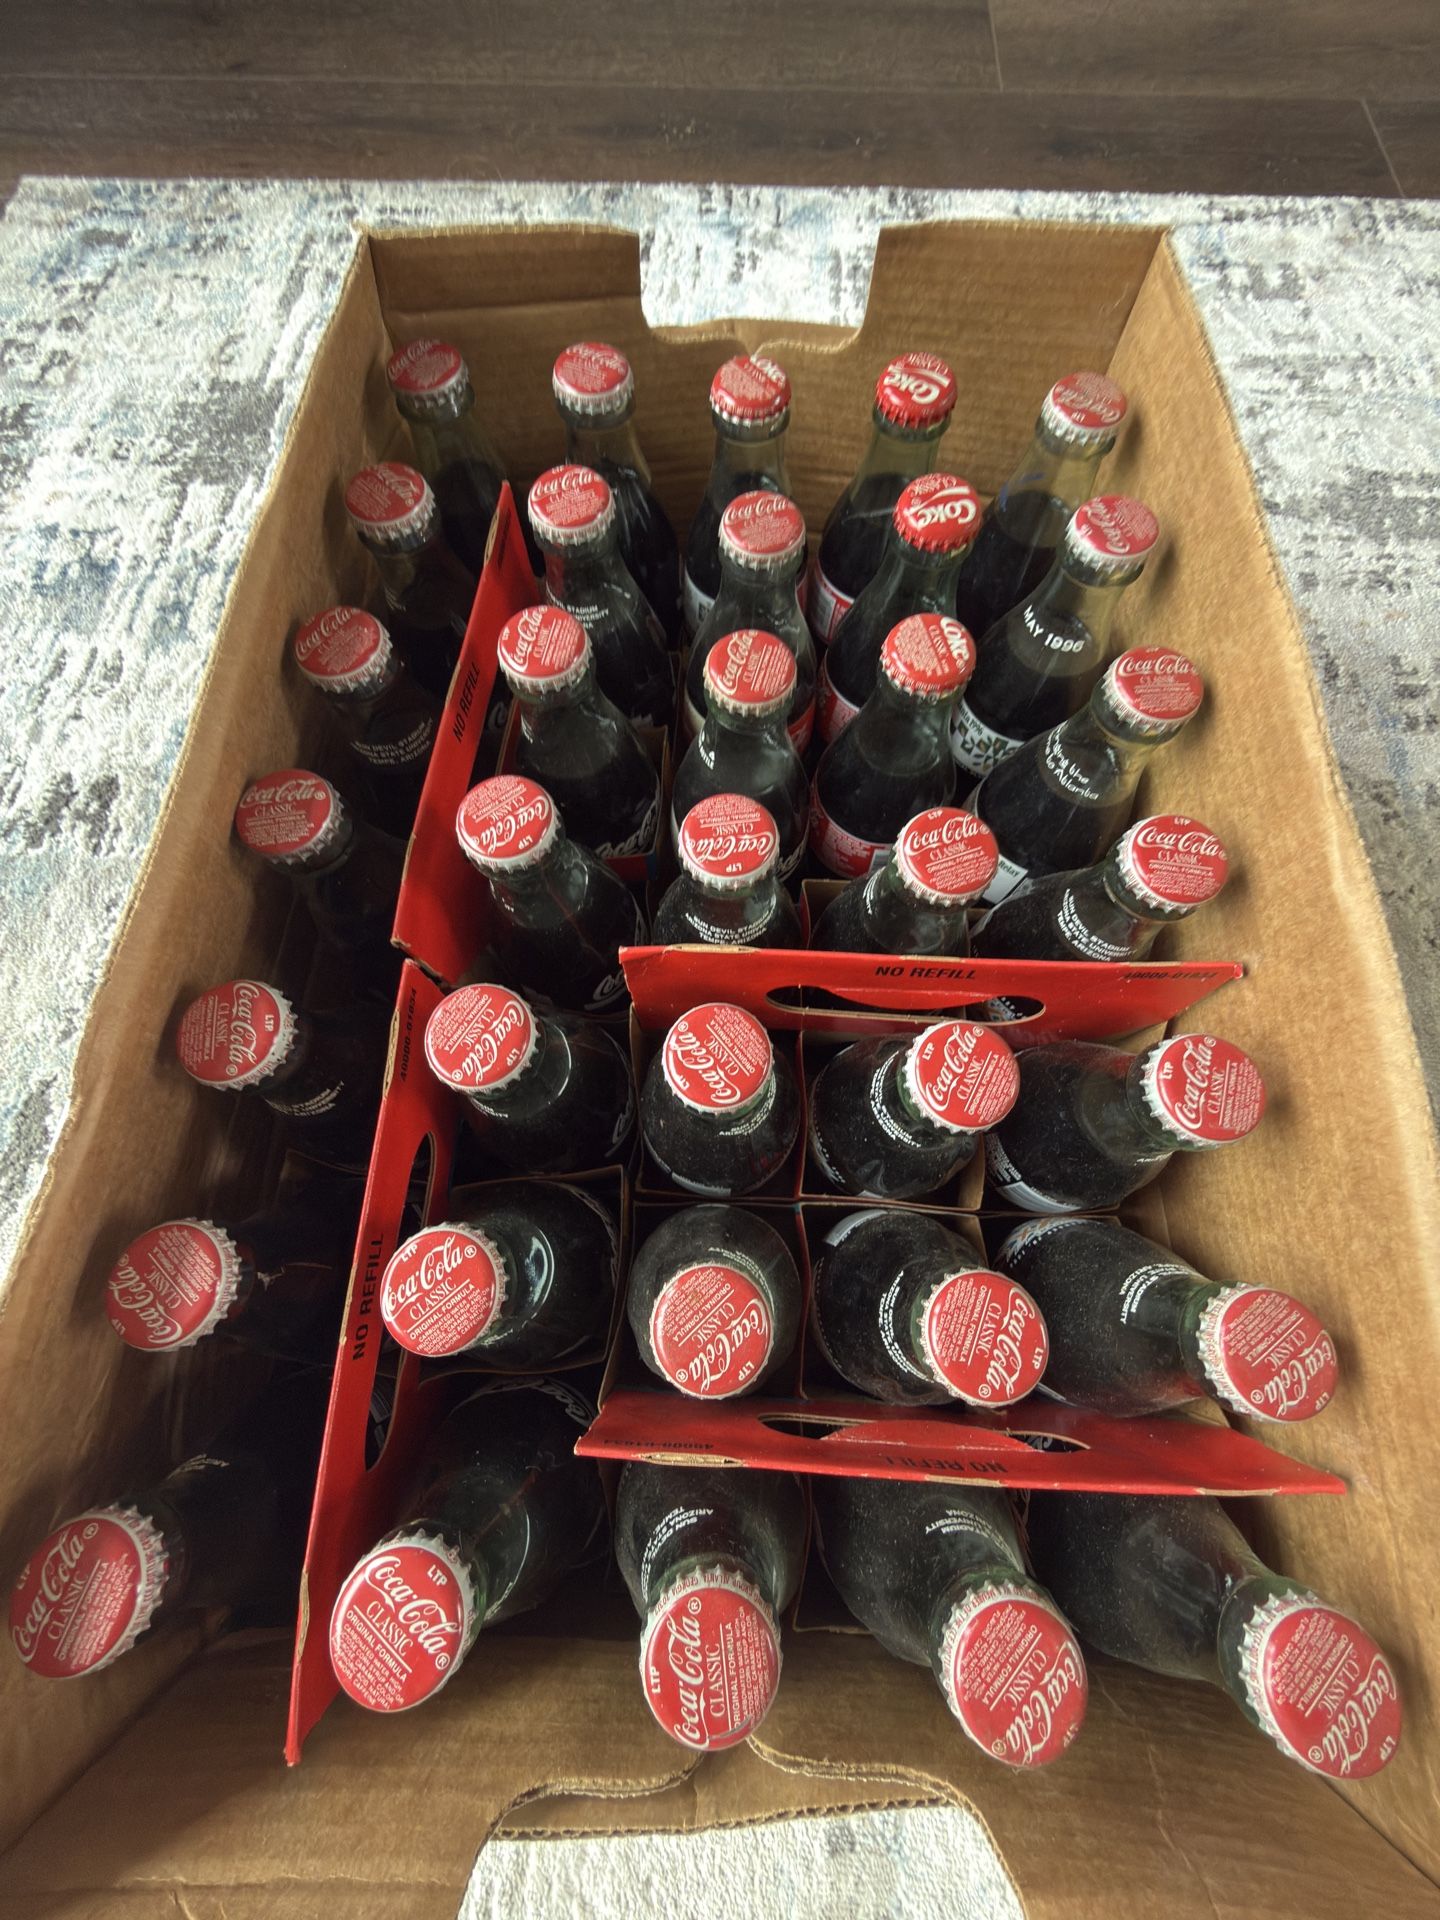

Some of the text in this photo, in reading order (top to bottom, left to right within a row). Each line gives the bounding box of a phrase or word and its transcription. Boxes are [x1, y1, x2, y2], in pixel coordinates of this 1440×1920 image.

[884, 371, 940, 404] Coke
[532, 469, 592, 500] Coca-Cola
[725, 496, 787, 525] Coca-Cola
[913, 500, 976, 530] Coke
[566, 604, 598, 614] STADIUM
[1024, 604, 1044, 637] MAY
[296, 609, 352, 660] Coca-Cola
[501, 610, 542, 673] Coca-Cola
[941, 617, 970, 665] Coke
[718, 632, 752, 695] Coca-Cola
[1119, 655, 1189, 677] Coca-Cola
[453, 662, 480, 744] NO REFILL
[242, 780, 318, 808] Coca-Cola
[255, 802, 294, 817] CLASSIC
[486, 796, 525, 825] CLASSIC
[481, 795, 549, 854] Coca-Cola
[713, 824, 754, 836] CLASSIC
[906, 815, 978, 855] Coca-Cola
[1138, 826, 1219, 856] Coca-Cola
[696, 831, 774, 865] Coca-Cola
[726, 863, 742, 872] LTP
[930, 842, 971, 860] CLASSIC
[1158, 851, 1201, 865] CLASSIC
[694, 916, 708, 928] SUN
[1068, 922, 1089, 943] STATE
[1072, 914, 1088, 937] DEVIL
[1090, 935, 1130, 951] STADIUM
[1072, 940, 1110, 961] ARIZONA
[874, 966, 976, 980] NO REFILL
[229, 983, 259, 1064] Coca-Cola
[265, 1014, 274, 1031] LTP
[462, 1009, 495, 1049] CLASSIC
[462, 1001, 525, 1083] Coca-Cola
[671, 1031, 741, 1104] Coca-Cola
[708, 1039, 738, 1075] CLASSIC
[922, 1043, 934, 1059] LTP
[924, 1025, 974, 1111] Coca-Cola
[957, 1057, 979, 1100] CLASSIC
[1174, 1039, 1214, 1129] Coca-Cola
[401, 1244, 418, 1261] LTP
[353, 1232, 384, 1360] NO REFILL
[382, 1235, 462, 1321] Coca-Cola
[409, 1277, 456, 1320] CLASSIC
[110, 1262, 182, 1343] Coca-Cola
[410, 1311, 442, 1339] ORIGINAL
[442, 1284, 475, 1312] FORMULA
[689, 1299, 766, 1392] Coca-Cola
[691, 1302, 734, 1348] CLASSIC
[976, 1302, 1001, 1358] CLASSIC
[987, 1287, 1035, 1396] Coca-Cola
[1032, 1348, 1043, 1370] LTP
[1271, 1329, 1305, 1370] CLASSIC
[739, 1363, 754, 1380] LTP
[1264, 1329, 1335, 1415] Coca-Cola
[1316, 1392, 1329, 1410] LTP
[669, 1509, 713, 1526] ARIZONA
[676, 1517, 698, 1531] SUN
[12, 1528, 85, 1663] Coca-Cola
[427, 1565, 448, 1586] LTP
[48, 1570, 88, 1639] CLASSIC
[364, 1556, 458, 1655] Coca-Cola
[346, 1611, 408, 1682] ORIGINAL FORMULA
[367, 1600, 413, 1656] CLASSIC
[651, 1667, 661, 1694] LTP
[667, 1614, 709, 1748] Coca-Cola
[705, 1644, 725, 1717] CLASSIC
[982, 1625, 1038, 1705] ORIGINAL FORMULA
[1004, 1650, 1047, 1710] CLASSIC
[1296, 1634, 1348, 1710] ORIGINAL FORMULA
[1005, 1641, 1083, 1765] Coca-Cola
[1319, 1659, 1360, 1719] CLASSIC
[1323, 1653, 1397, 1775] Coca-Cola
[1380, 1736, 1396, 1760] LTP
